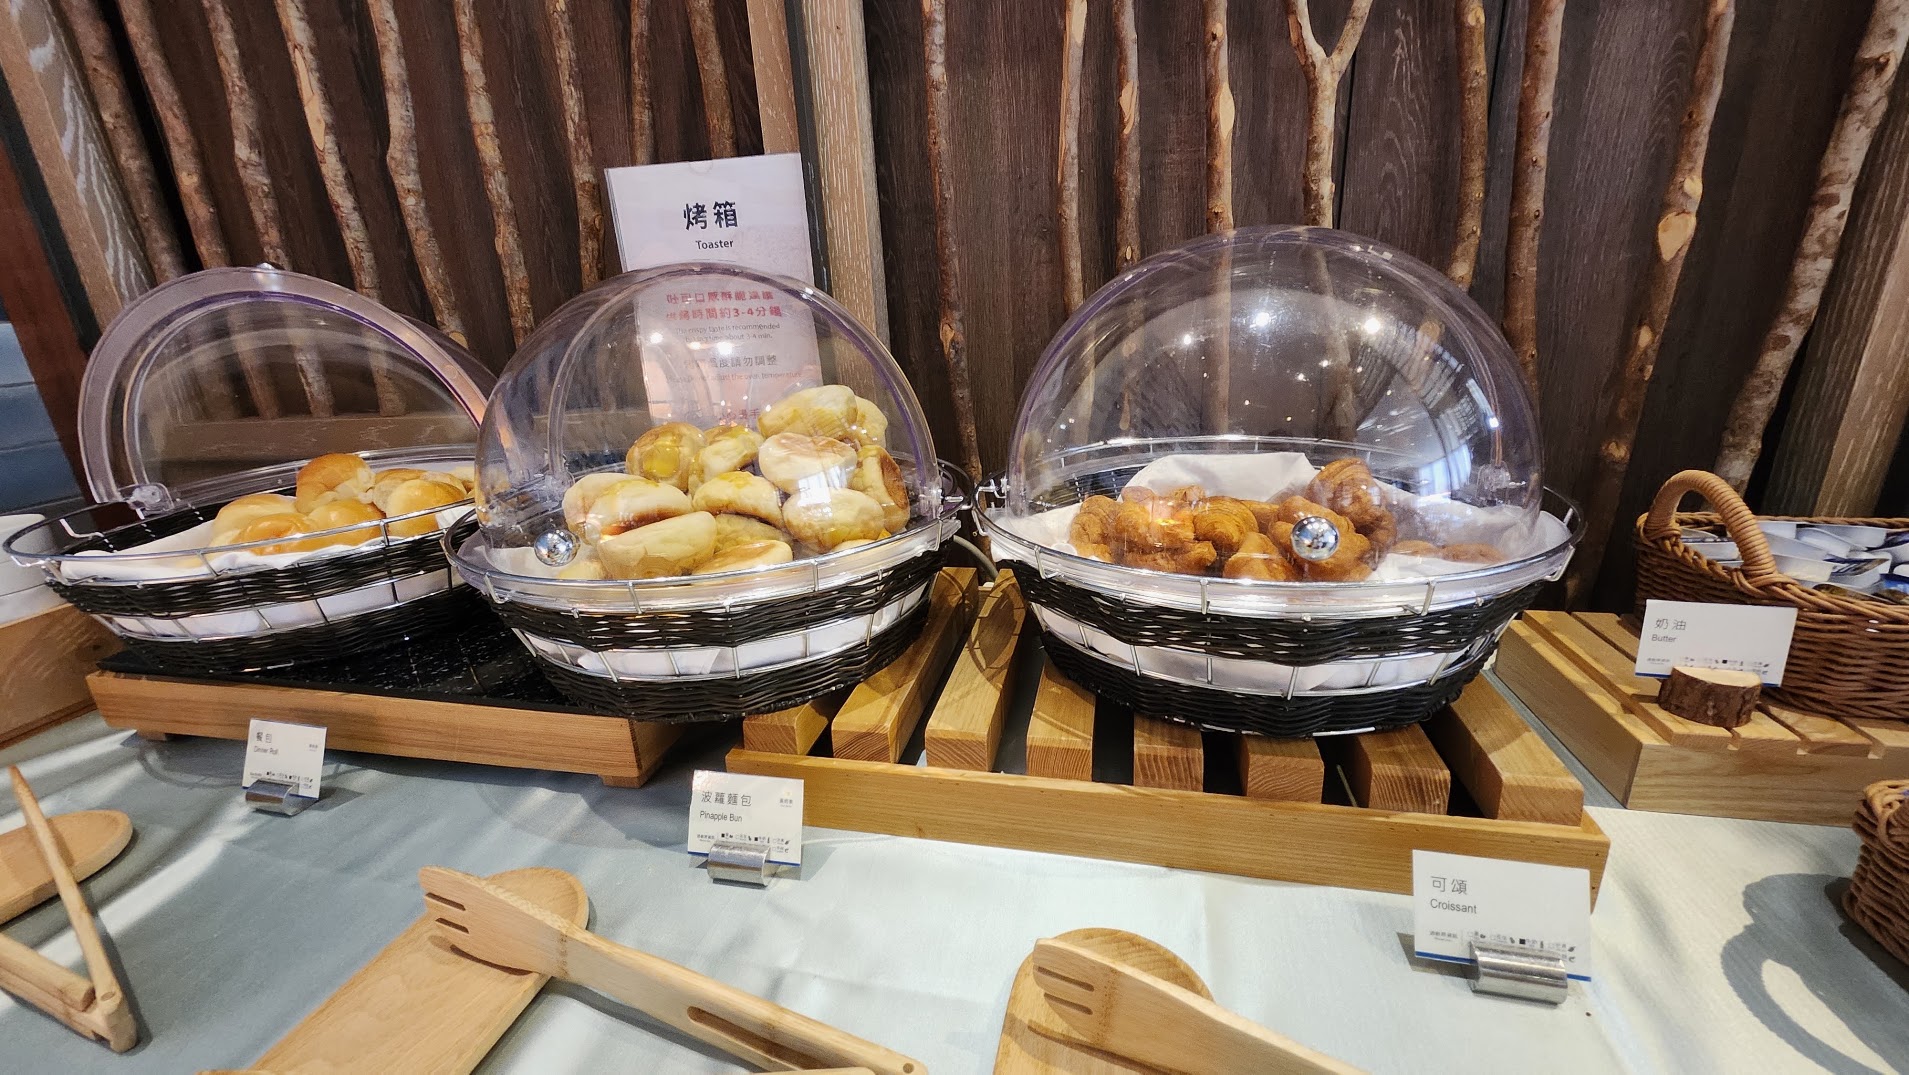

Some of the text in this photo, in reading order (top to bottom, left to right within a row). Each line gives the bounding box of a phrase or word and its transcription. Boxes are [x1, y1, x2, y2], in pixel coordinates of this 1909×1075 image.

[683, 201, 738, 230] 烤箱
[695, 239, 734, 250] Toaster
[732, 323, 781, 331] recommended
[1655, 618, 1686, 631] 奶油
[1651, 634, 1676, 643] Butter
[699, 810, 742, 822] Pinapple Bun
[1430, 876, 1468, 895] 可頌
[1430, 898, 1477, 914] Croissant
